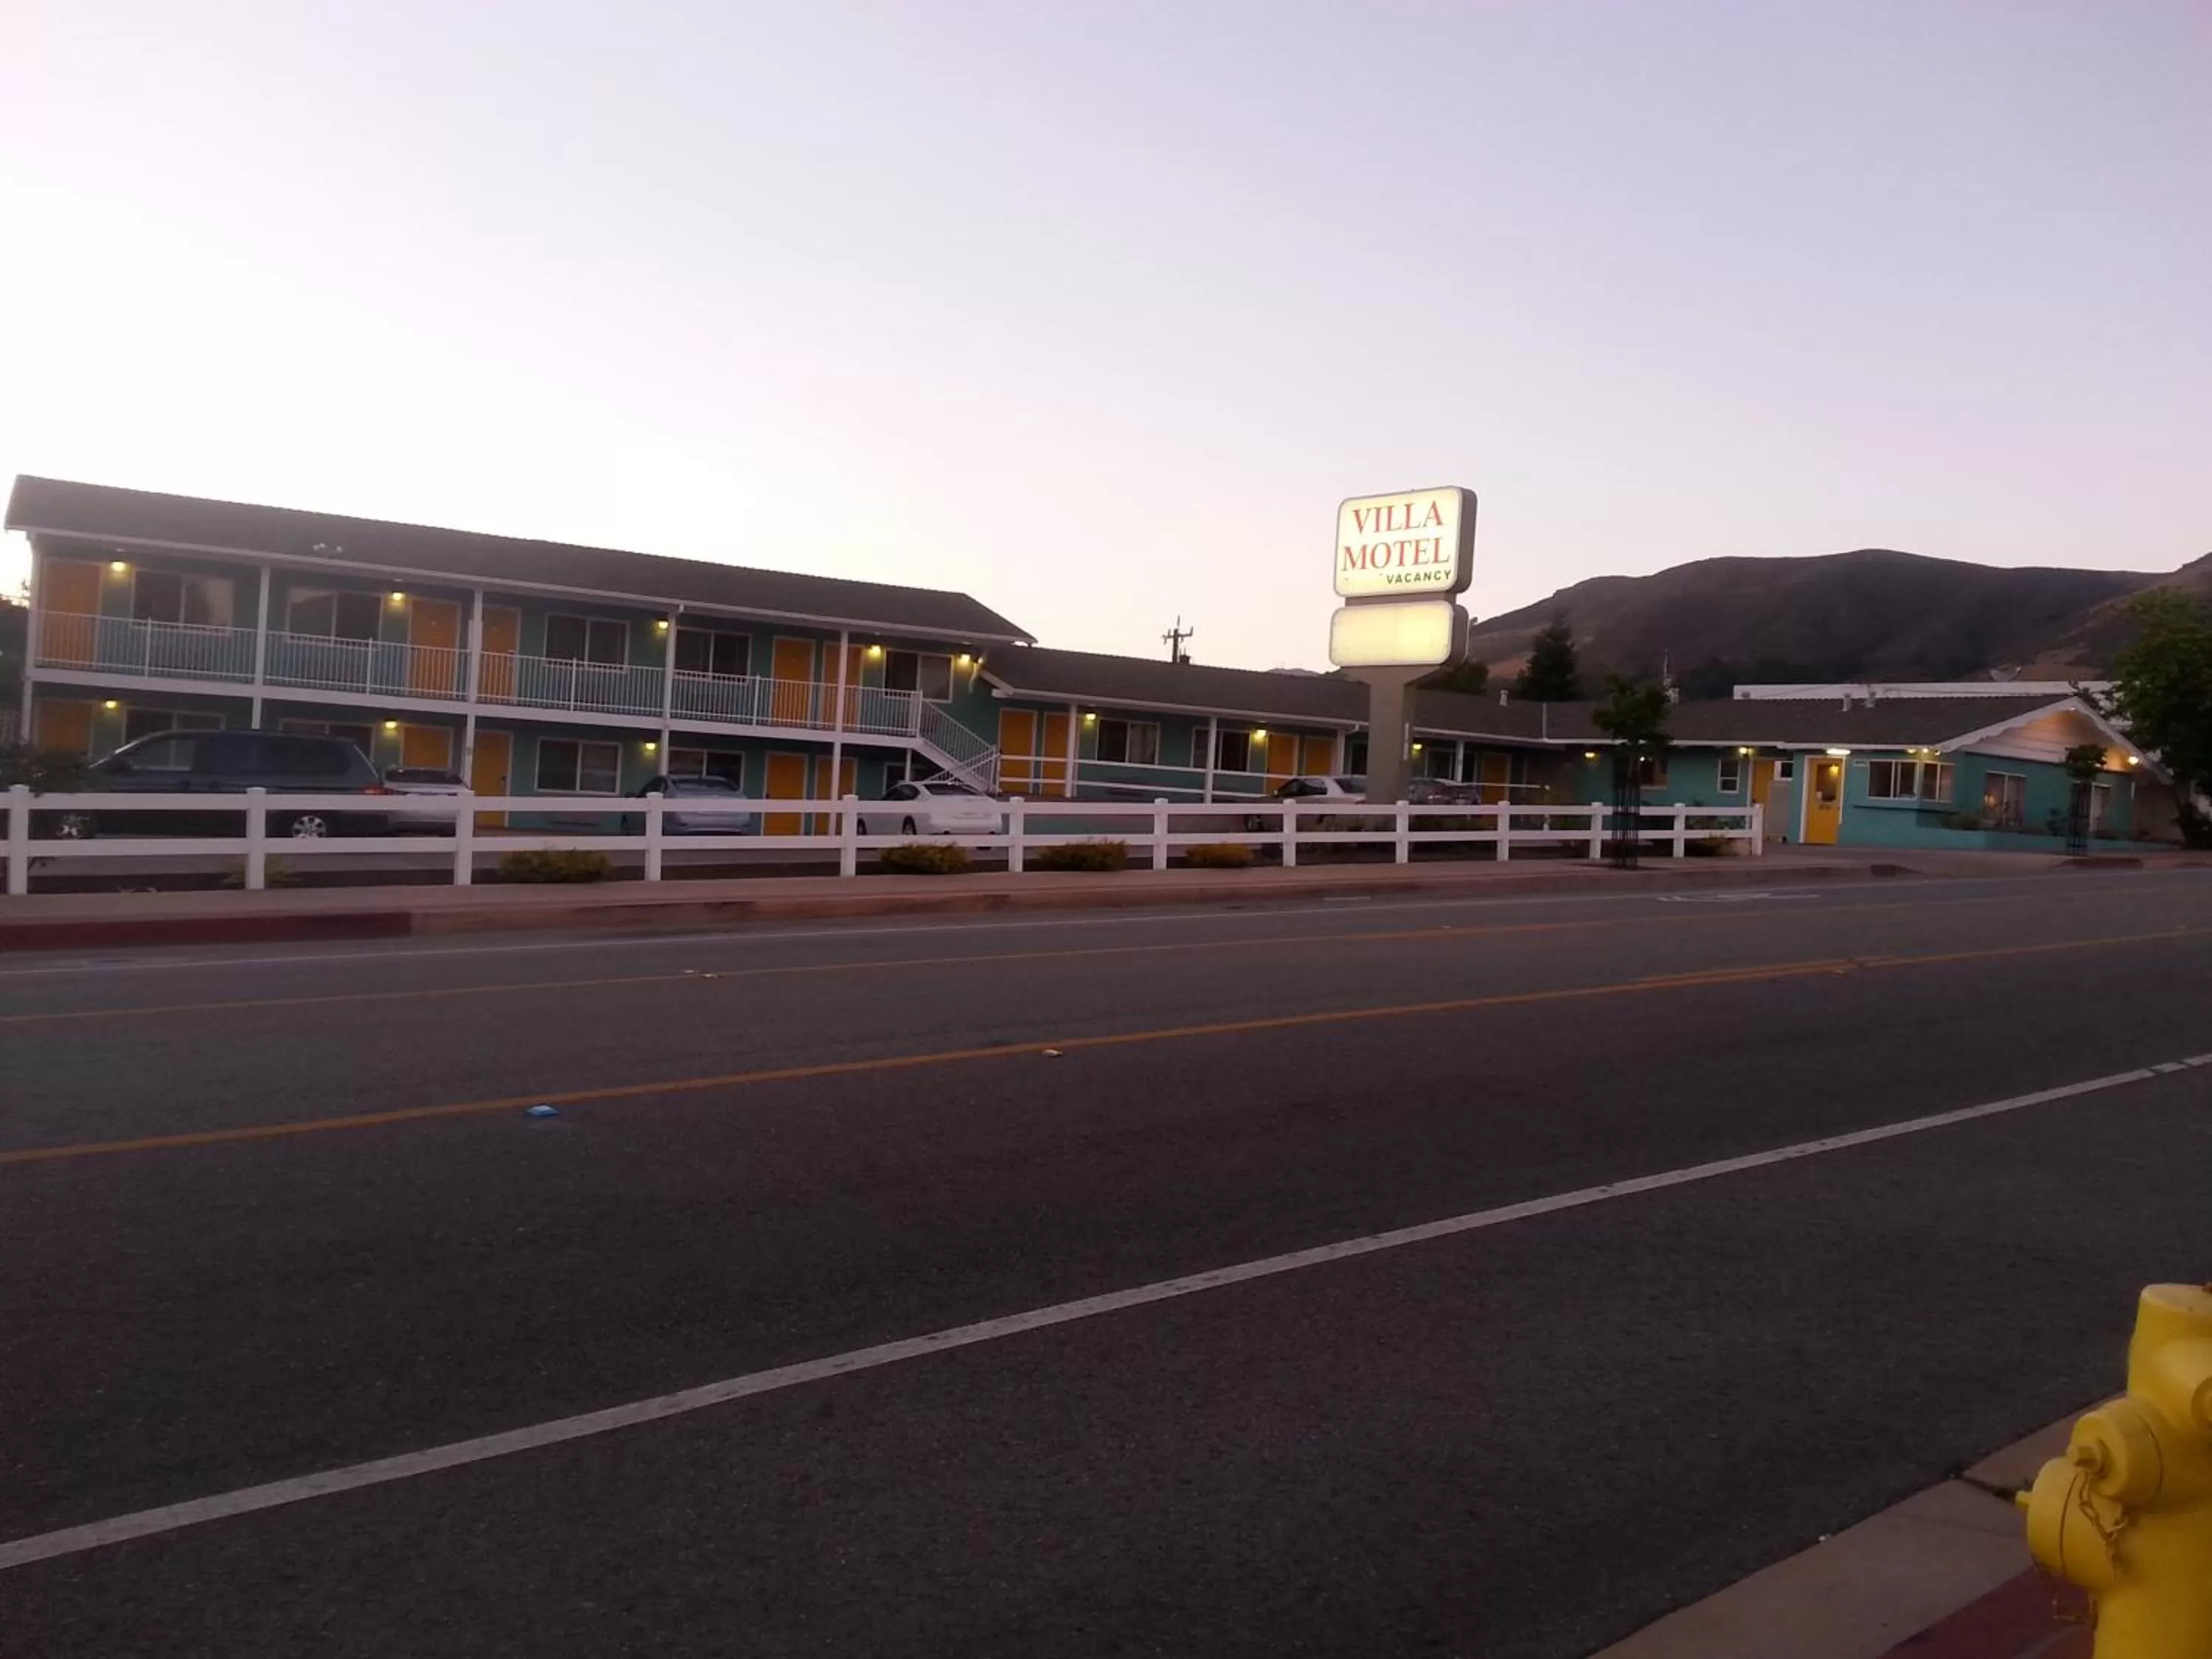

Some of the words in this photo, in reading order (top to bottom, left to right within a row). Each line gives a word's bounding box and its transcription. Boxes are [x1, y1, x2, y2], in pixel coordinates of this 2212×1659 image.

[1352, 501, 1444, 534] VILLA
[1342, 538, 1450, 571] MOTEL
[1386, 570, 1451, 584] VACANCY
